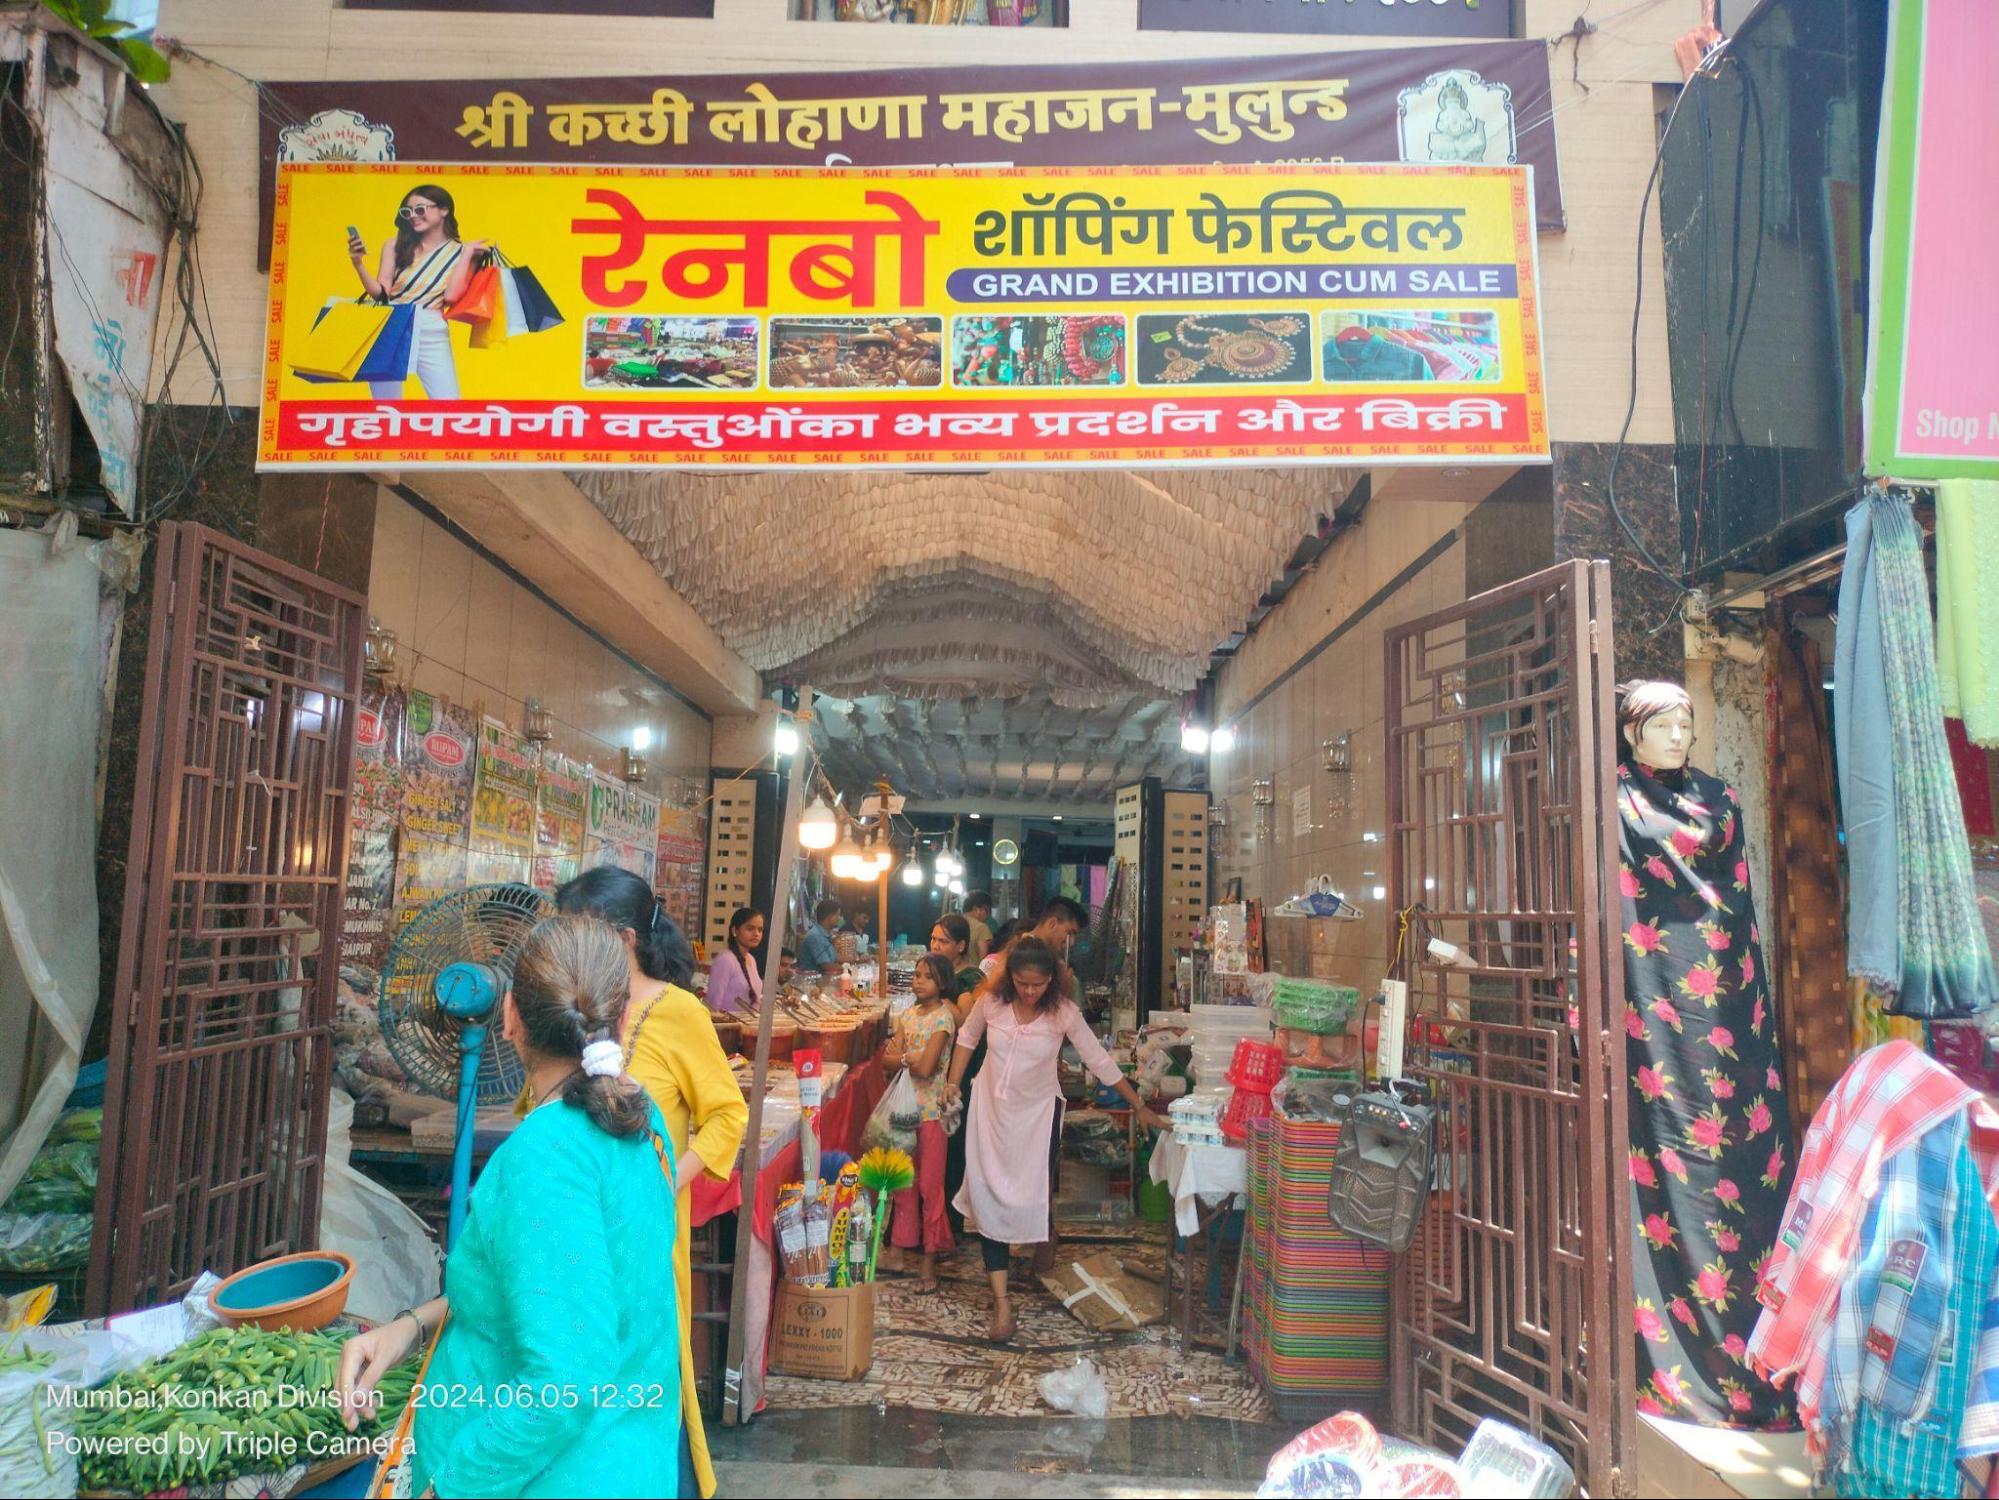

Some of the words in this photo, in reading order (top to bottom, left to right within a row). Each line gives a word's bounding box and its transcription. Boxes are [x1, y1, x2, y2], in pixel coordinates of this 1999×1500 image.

[456, 92, 534, 148] श्री
[547, 89, 694, 147] कच्छी
[706, 83, 928, 150] लोहाणा
[281, 164, 309, 173] SALE
[326, 165, 354, 174] SALE
[371, 165, 399, 174] SALE
[416, 165, 443, 174] SALE
[460, 166, 489, 175] SALE
[505, 166, 534, 175] SALE
[550, 166, 578, 176] SALE
[595, 167, 623, 176] SALE
[640, 167, 668, 176] SALE
[684, 167, 712, 177] SALE
[729, 168, 757, 177] SALE
[774, 168, 801, 177] SALE
[818, 168, 846, 177] SALE
[863, 168, 891, 177] SALE
[908, 168, 936, 177] SALE
[953, 167, 981, 177] SALE
[998, 167, 1026, 177] SALE
[1043, 167, 1071, 176] SALE
[1088, 167, 1116, 176] SALE
[1132, 167, 1161, 176] SALE
[1177, 167, 1206, 176] SALE
[1223, 166, 1251, 176] SALE
[1268, 166, 1296, 176] SALE
[1313, 166, 1341, 176] SALE
[1358, 166, 1386, 176] SALE
[1403, 167, 1431, 176] SALE
[1447, 167, 1476, 176] SALE
[1492, 167, 1520, 176] SALE
[278, 183, 288, 206] SALE
[1514, 185, 1525, 208] SALE
[276, 222, 286, 244] SALE
[973, 190, 1175, 257] शॉपिंग
[1186, 189, 1467, 256] फेस्टिवल
[1516, 222, 1528, 244] SALE
[571, 188, 940, 309] रेनबो
[274, 260, 284, 284] SALE
[1520, 259, 1531, 280] SALE
[973, 274, 1099, 298] GRAND
[1110, 271, 1307, 296] EXHIBITION
[1319, 270, 1397, 294] CUM
[1408, 268, 1501, 293] SALE
[272, 300, 282, 323] SALE
[1523, 295, 1534, 318] SALE
[270, 339, 280, 362] SALE
[1525, 333, 1536, 356] SALE
[267, 378, 278, 401] SALE
[1528, 371, 1540, 394] SALE
[264, 418, 275, 441] SALE
[298, 404, 590, 447] गृहोपयोगी
[602, 406, 879, 448] वस्तुओंका
[894, 413, 1019, 438] भव्य
[1029, 402, 1219, 437] प्रदर्शन
[1238, 400, 1345, 433] और
[1355, 399, 1508, 432] बिक्री
[1532, 410, 1543, 434] SALE
[1916, 408, 1979, 446] Shop
[264, 452, 292, 461] SALE
[309, 452, 337, 461] SALE
[353, 451, 382, 461] SALE
[399, 451, 427, 460] SALE
[445, 451, 473, 461] SALE
[490, 452, 520, 461] SALE
[537, 452, 565, 461] SALE
[583, 452, 612, 462] SALE
[629, 453, 658, 462] SALE
[676, 453, 705, 462] SALE
[722, 453, 751, 462] SALE
[768, 453, 797, 462] SALE
[814, 453, 843, 462] SALE
[860, 452, 889, 462] SALE
[906, 452, 935, 462] SALE
[952, 452, 980, 461] SALE
[998, 451, 1027, 461] SALE
[1044, 450, 1073, 460] SALE
[1090, 450, 1120, 460] SALE
[1136, 449, 1165, 459] SALE
[1183, 448, 1212, 458] SALE
[1229, 447, 1259, 457] SALE
[1276, 446, 1305, 456] SALE
[1323, 446, 1353, 455] SALE
[1370, 445, 1400, 455] SALE
[1417, 445, 1447, 455] SALE
[1465, 445, 1495, 454] SALE
[1513, 444, 1543, 454] SALE
[605, 786, 656, 831] PRAAM
[343, 919, 384, 934] MUKHWAS
[820, 1327, 843, 1339] 1000
